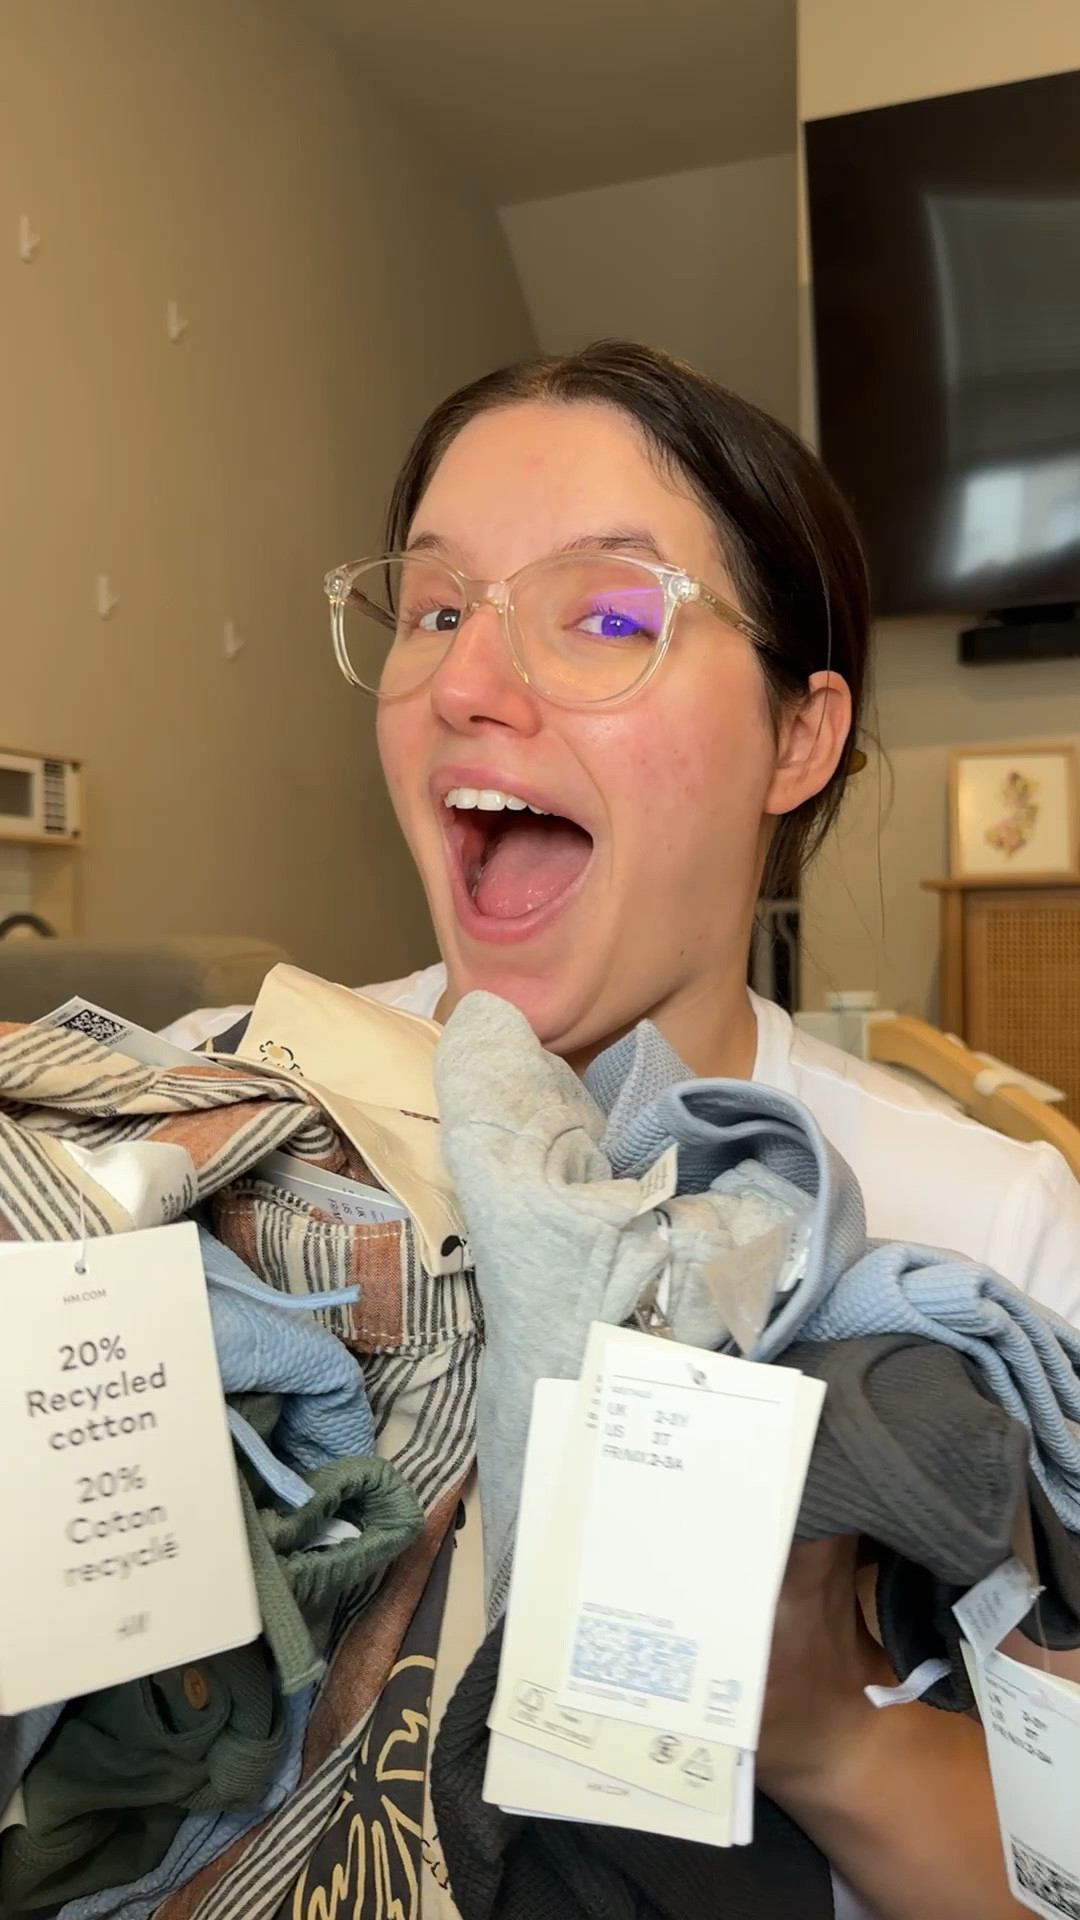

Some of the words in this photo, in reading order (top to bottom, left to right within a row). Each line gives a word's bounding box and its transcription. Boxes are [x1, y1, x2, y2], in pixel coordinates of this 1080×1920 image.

[63, 1288, 107, 1304] HM.COM
[58, 1334, 126, 1371] 20%
[25, 1362, 167, 1417] Recycled
[49, 1410, 156, 1450] cotton
[605, 1422, 625, 1438] US
[74, 1464, 146, 1504] 20%
[65, 1505, 168, 1544] Coton
[65, 1531, 180, 1587] recyclé
